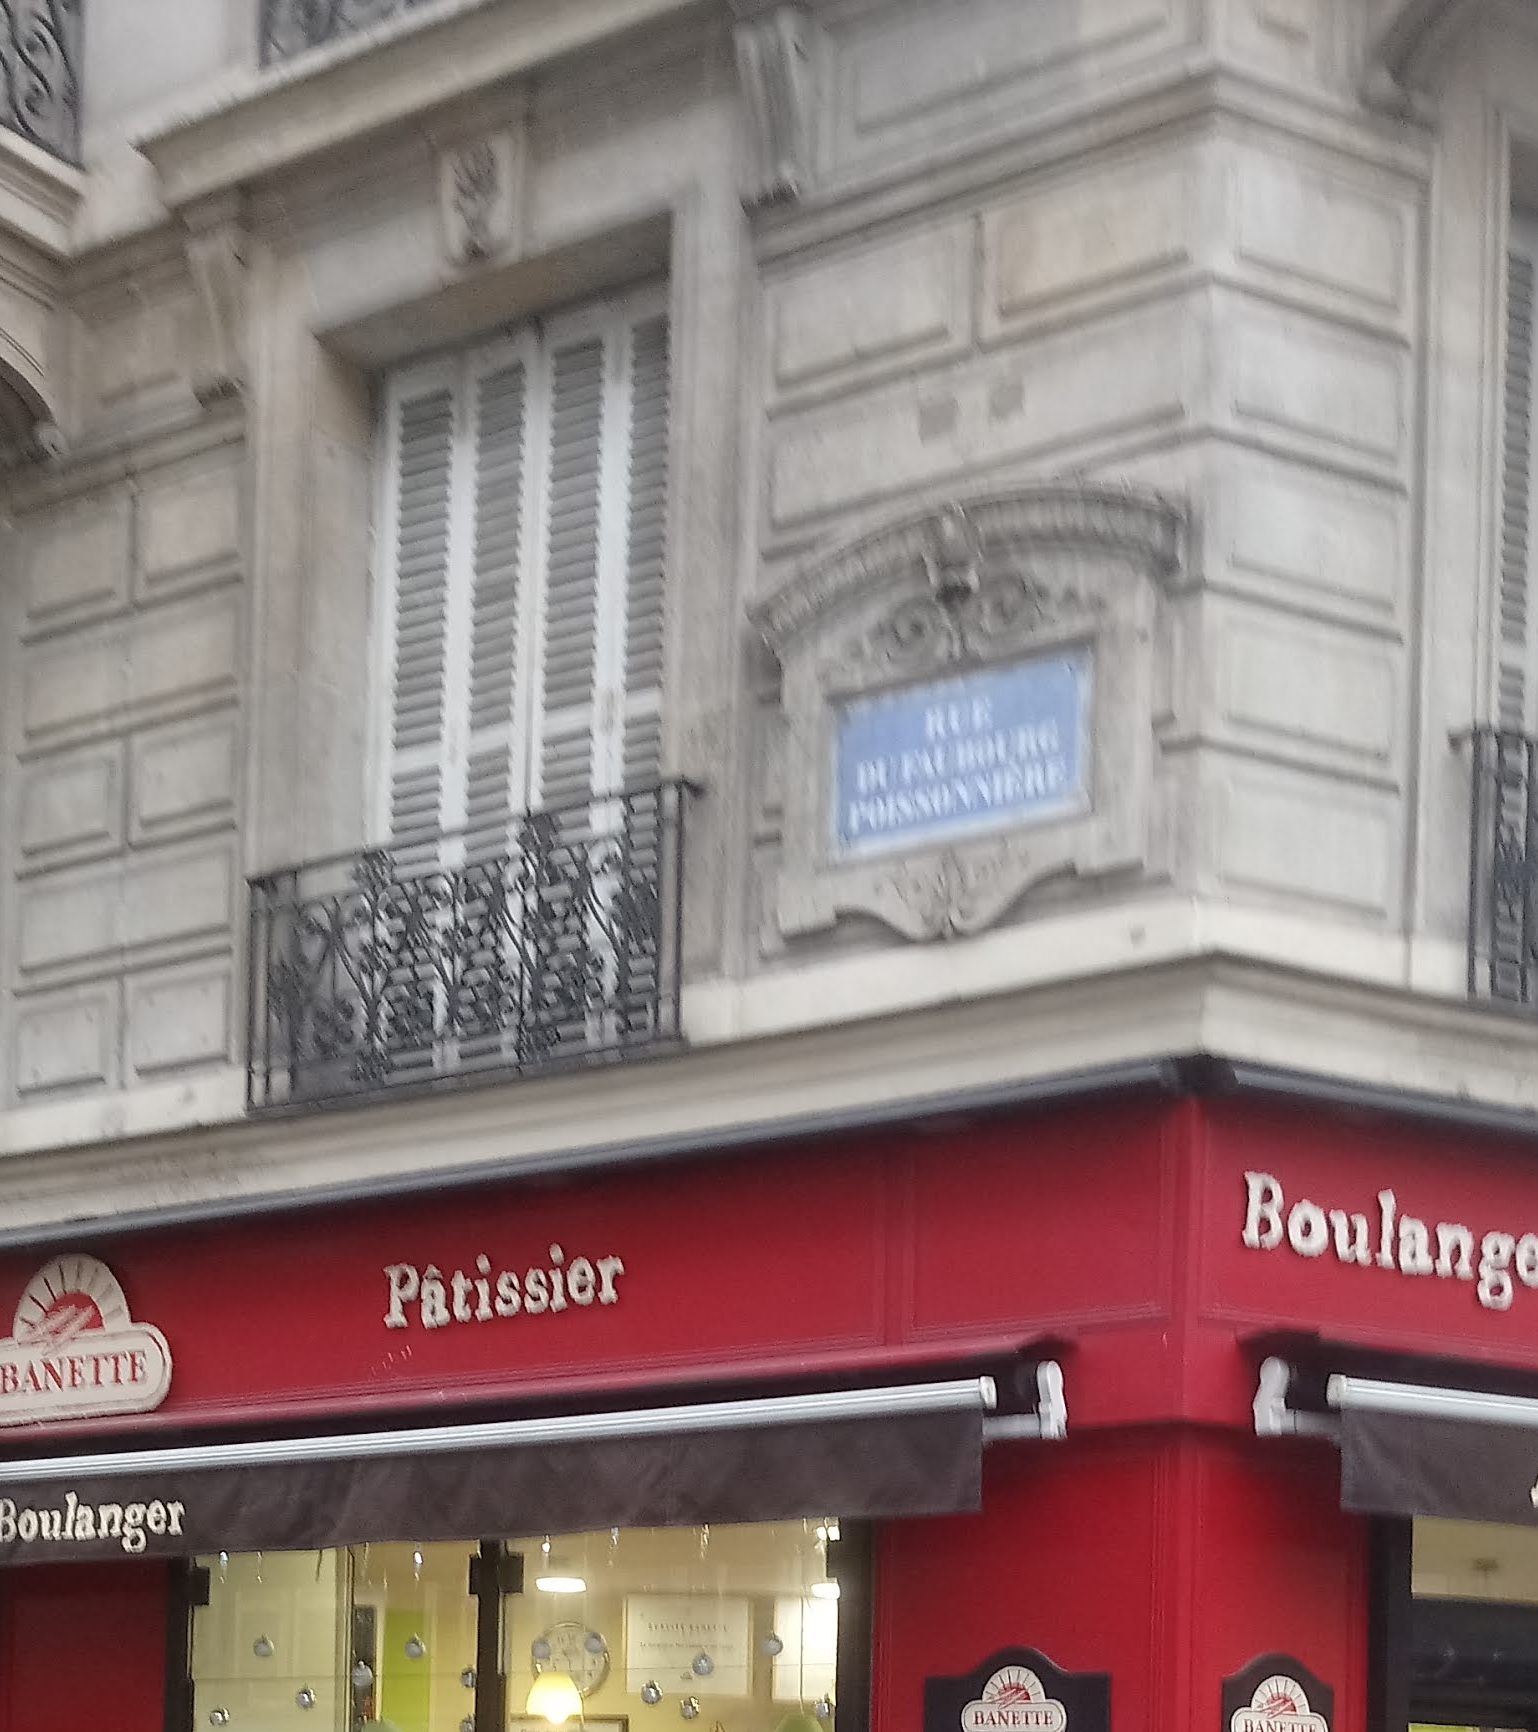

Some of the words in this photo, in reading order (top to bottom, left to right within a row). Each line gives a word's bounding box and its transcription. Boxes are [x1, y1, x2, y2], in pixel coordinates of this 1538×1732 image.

[925, 696, 993, 740] RUE
[900, 718, 1060, 783] FAUBOURG
[383, 1243, 625, 1329] Pâtissier
[973, 1709, 1054, 1727] BANETTE
